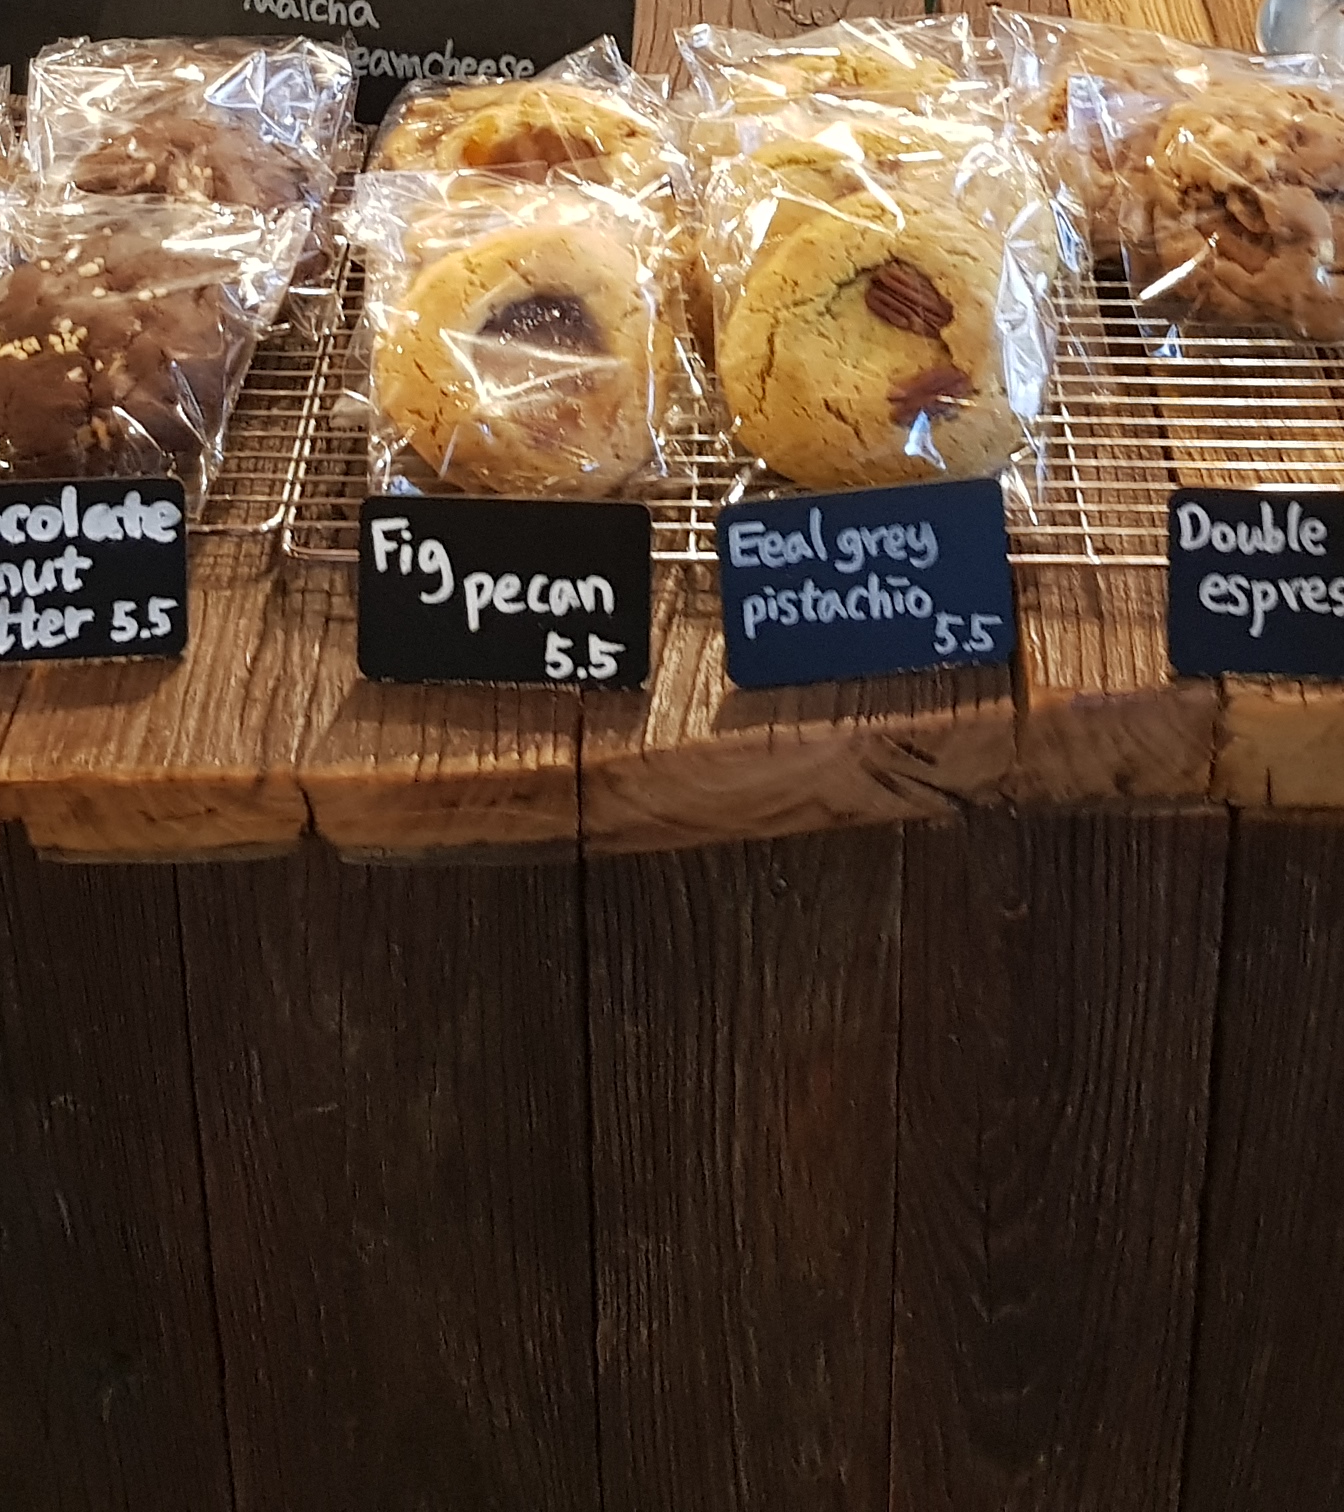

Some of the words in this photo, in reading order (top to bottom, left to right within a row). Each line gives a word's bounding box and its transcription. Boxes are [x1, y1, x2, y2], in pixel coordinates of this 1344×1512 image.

[350, 38, 535, 80] eamcheese
[834, 521, 939, 574] grey
[1177, 500, 1328, 556] Double
[372, 517, 454, 604] Fig
[464, 571, 614, 633] pecan
[110, 596, 178, 642] 5.5
[742, 571, 933, 640] pistachio
[545, 631, 626, 680] 5.5
[933, 611, 1004, 655] 5.5
